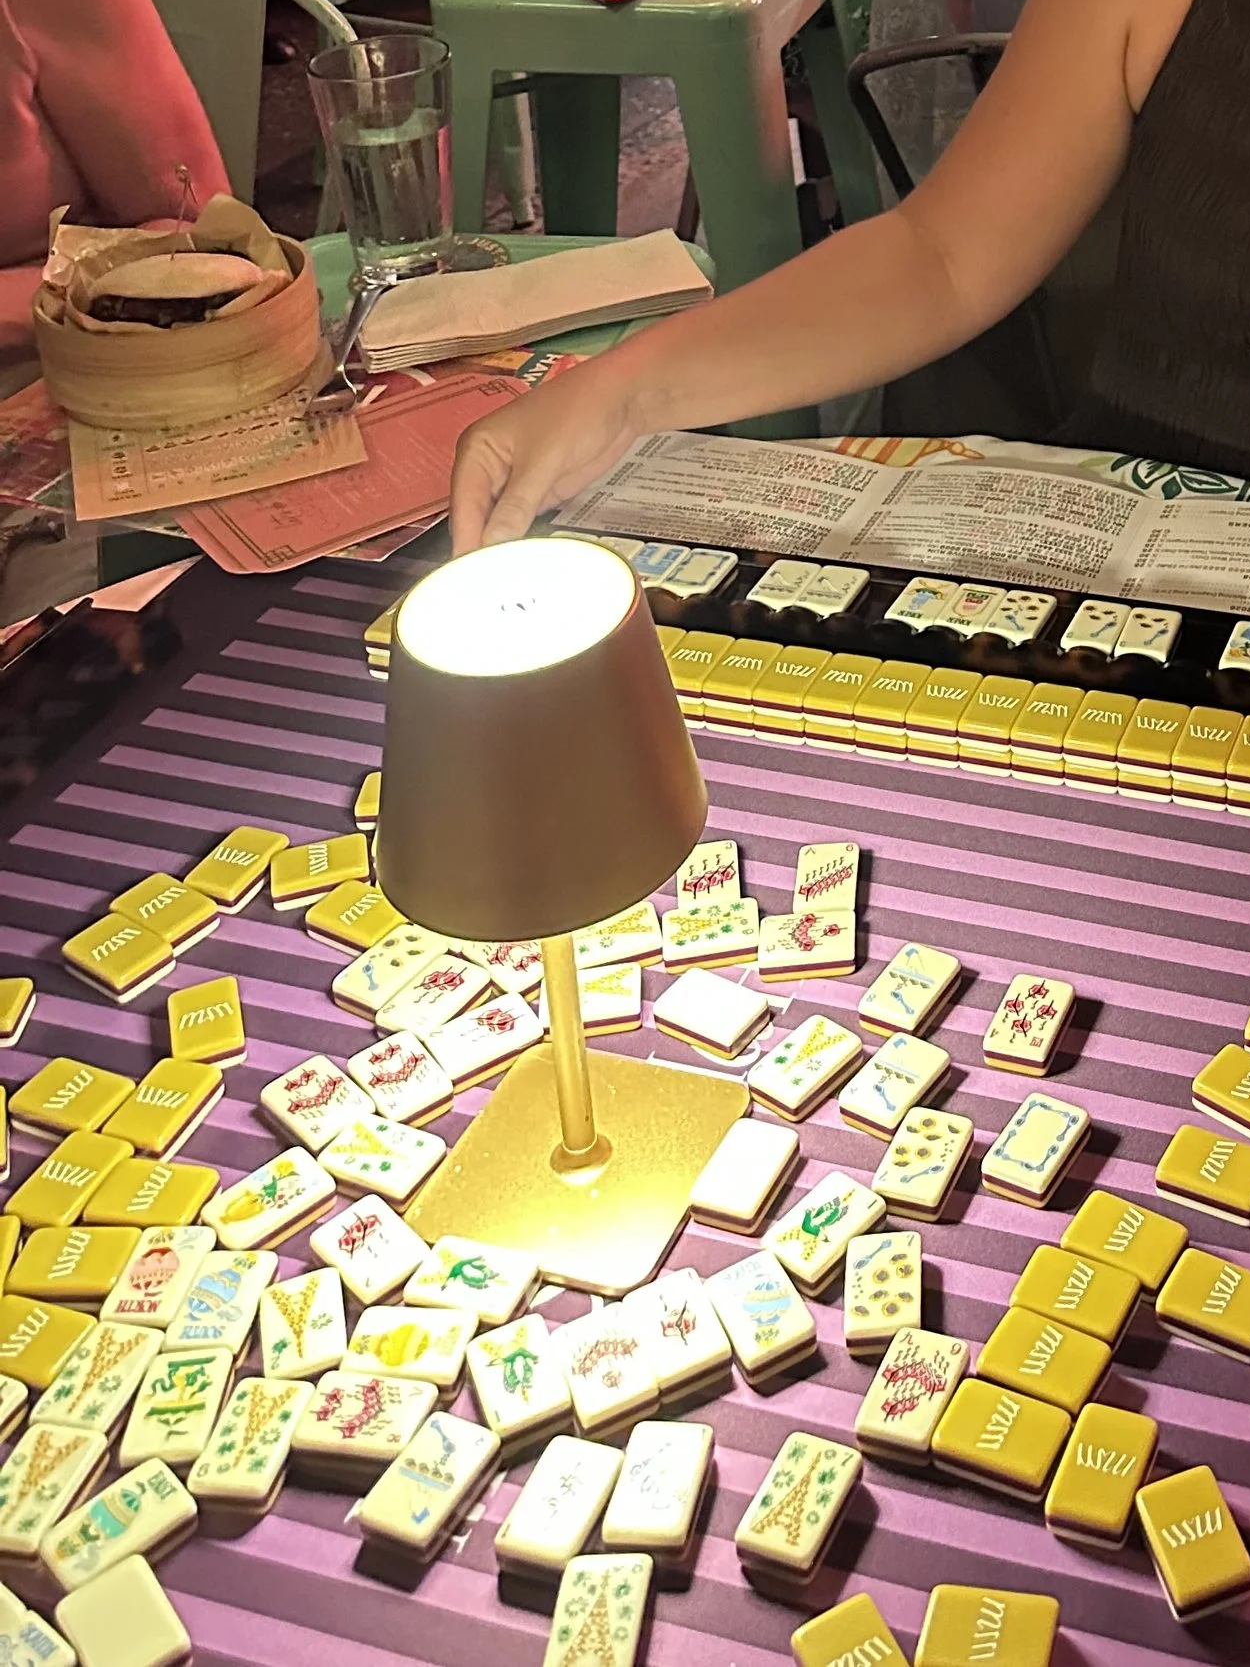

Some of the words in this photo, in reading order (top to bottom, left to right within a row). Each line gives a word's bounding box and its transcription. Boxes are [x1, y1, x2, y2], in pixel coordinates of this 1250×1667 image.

[115, 1299, 162, 1314] NORTH
[179, 1325, 226, 1340] SOUTH
[147, 1470, 178, 1501] EAST
